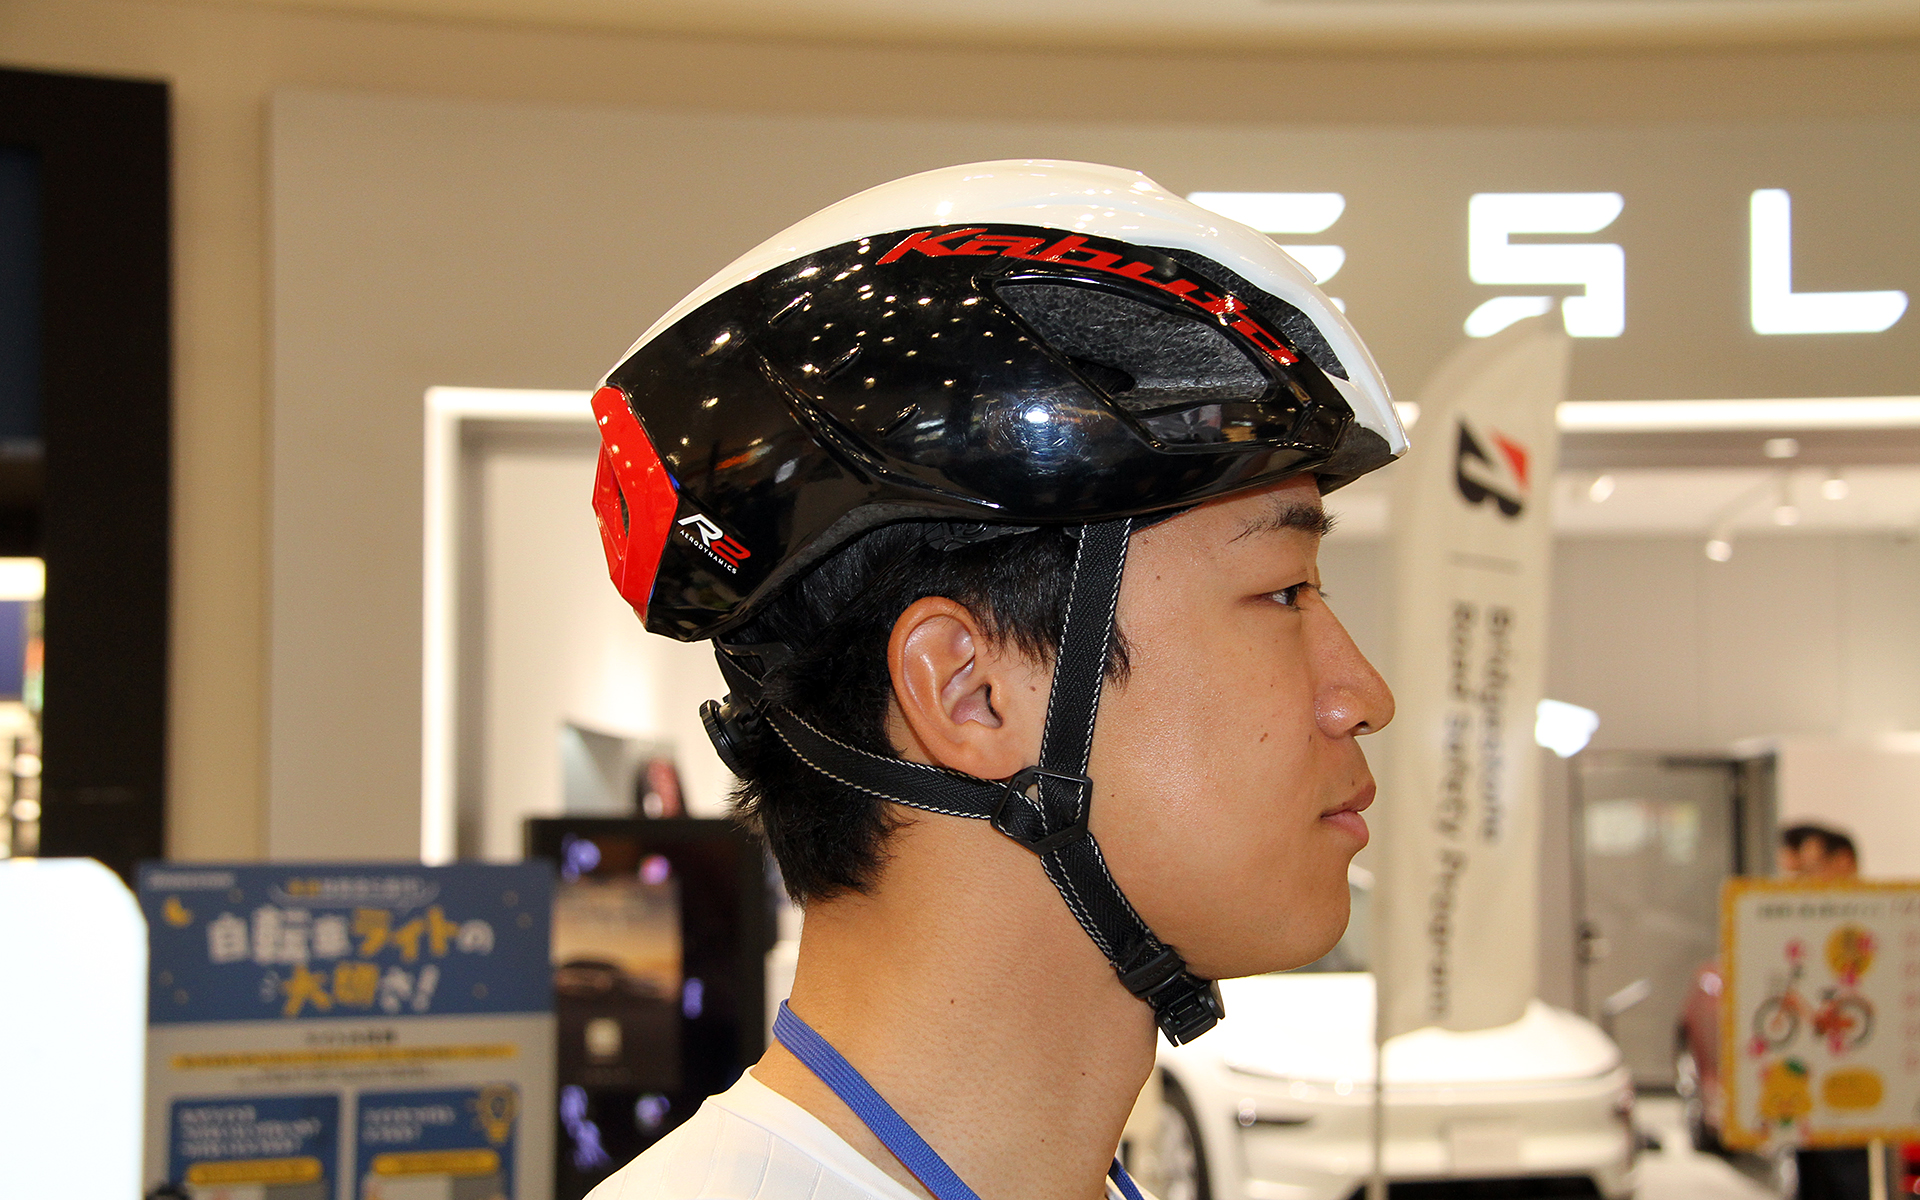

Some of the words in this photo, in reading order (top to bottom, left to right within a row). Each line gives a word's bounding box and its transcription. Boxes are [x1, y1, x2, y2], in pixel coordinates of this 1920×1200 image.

[876, 228, 1299, 366] Kabuto
[677, 513, 752, 569] R2
[680, 529, 737, 575] AERODYNAMICS
